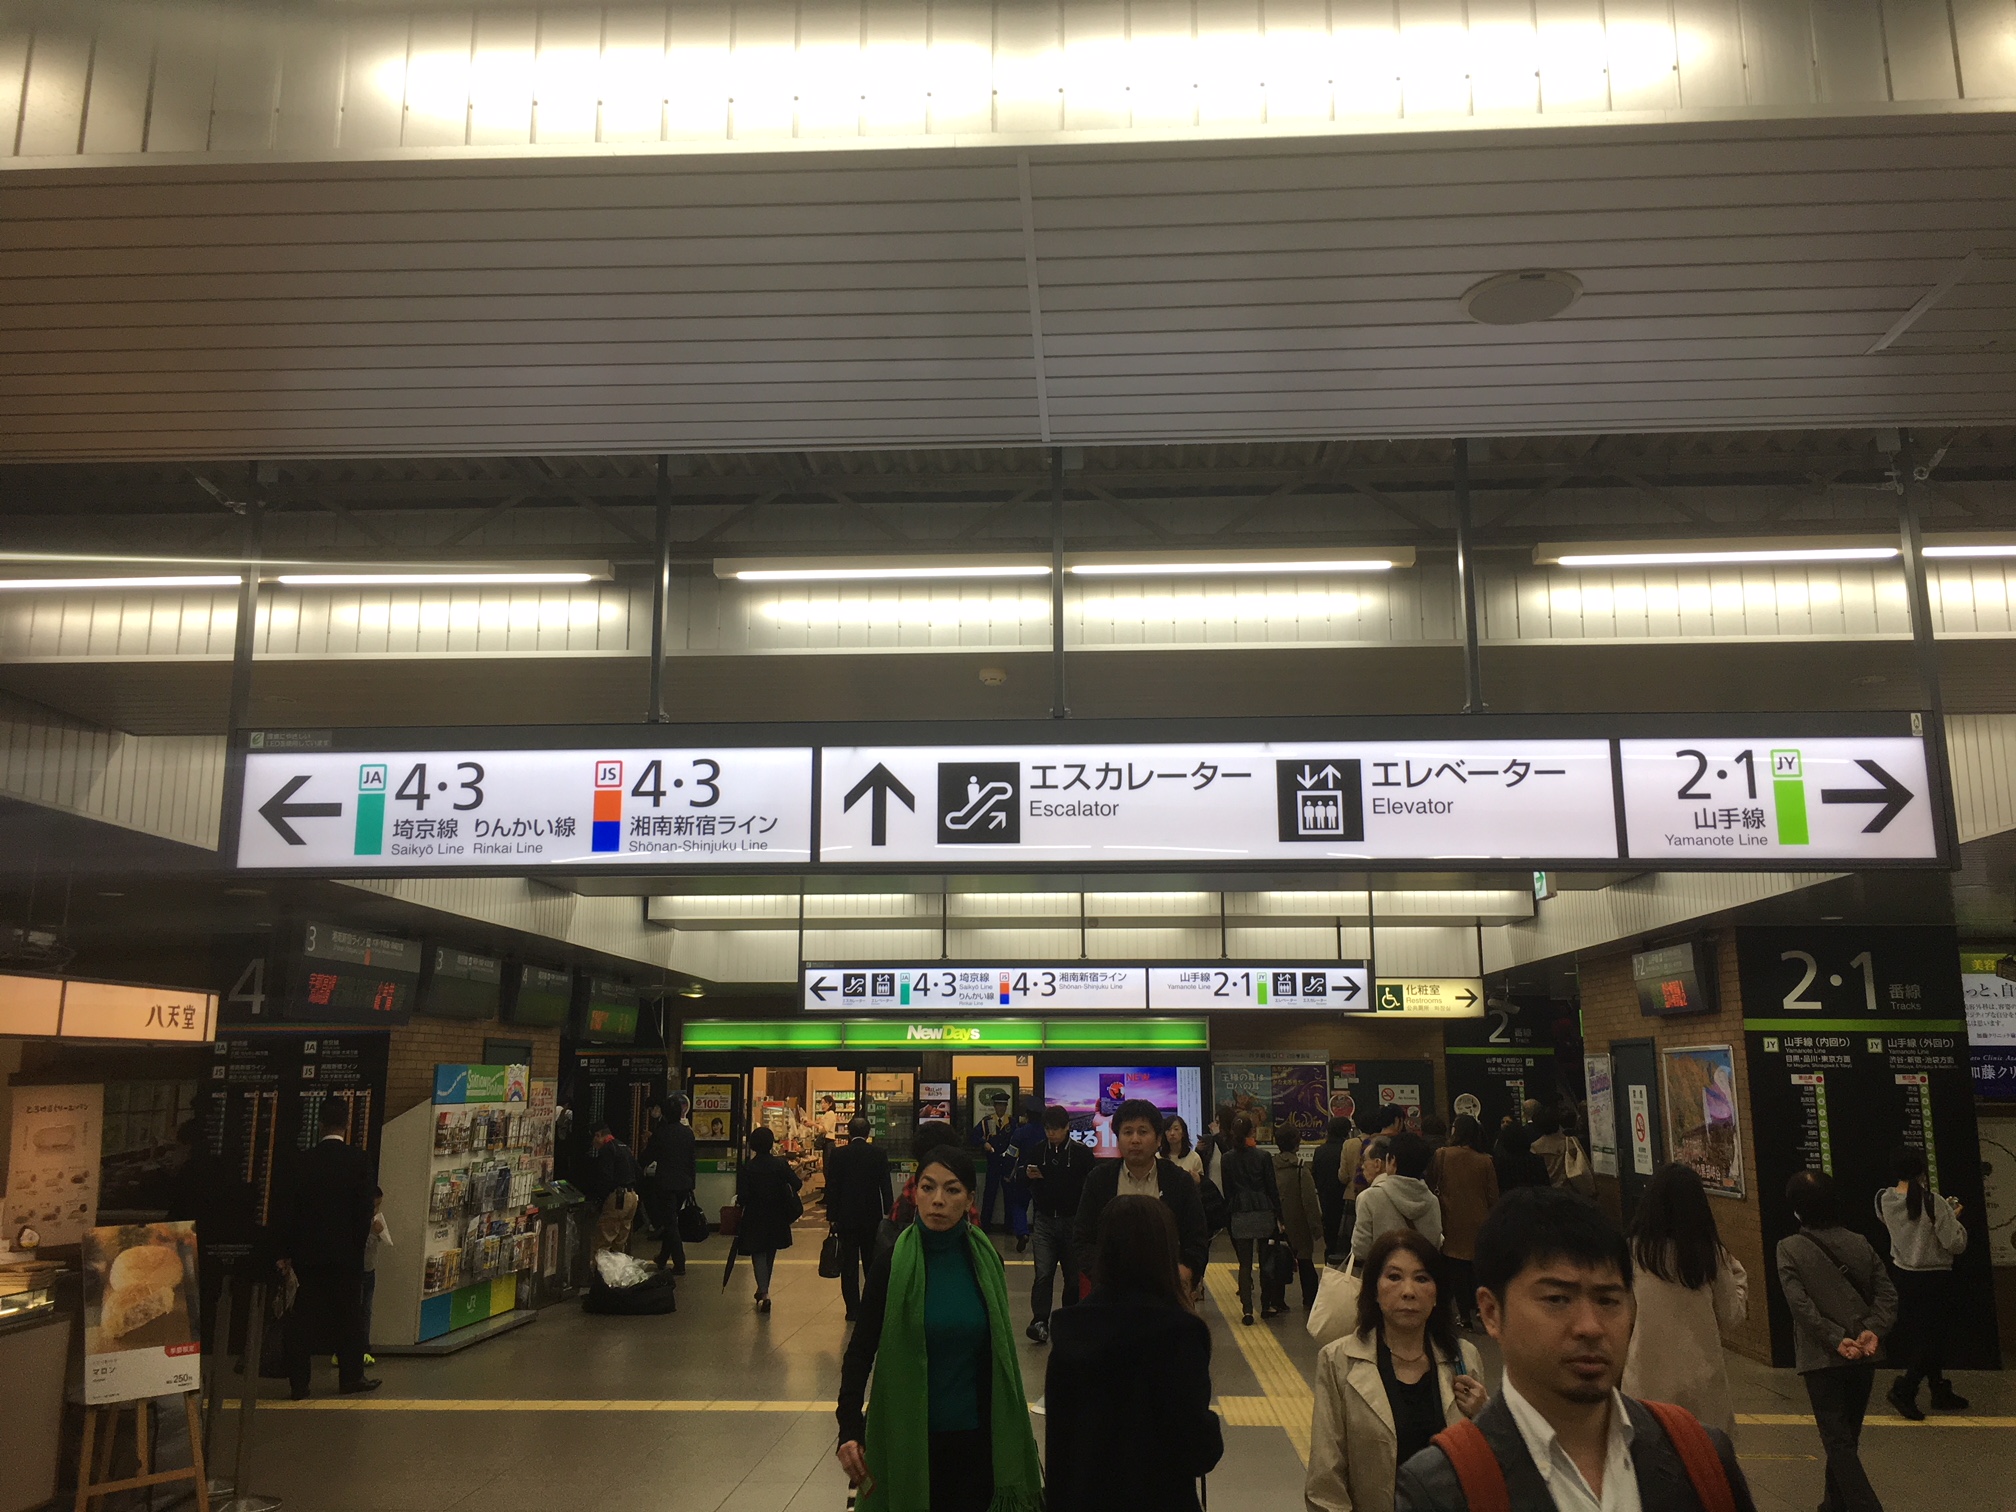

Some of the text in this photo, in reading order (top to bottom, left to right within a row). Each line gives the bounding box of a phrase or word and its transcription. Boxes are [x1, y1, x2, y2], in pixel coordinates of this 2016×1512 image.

[1777, 756, 1796, 770] JY
[363, 771, 382, 785] JA
[601, 767, 617, 781] JS
[1029, 761, 1251, 791] エスカレーター
[1372, 758, 1566, 788] エレベーター
[1029, 800, 1119, 817] Escalator
[1373, 797, 1454, 814] Elevator
[1694, 807, 1766, 830] 山手線
[392, 816, 577, 839] 埼京線 りんかい線
[630, 815, 778, 837] 湘南新宿ライン
[629, 840, 768, 854] Shōnan-Shinjuku Line
[1665, 834, 1768, 846] Yamanote Line
[391, 842, 543, 856] Saikyō Line Rinkai Line
[307, 926, 317, 952] 3
[436, 950, 444, 970] 3
[959, 972, 990, 982] 埼京線
[1059, 972, 1127, 982] 湘南新宿ライン
[1180, 972, 1210, 983] 山手線
[228, 958, 266, 1015] 4
[1406, 984, 1440, 996] 化粧室
[1889, 983, 1922, 999] 番線
[958, 992, 995, 1000] りんかい線
[1891, 1001, 1922, 1010] Tracks
[145, 1004, 196, 1030] 八天堂
[906, 1025, 981, 1041] NewDays
[1488, 1009, 1511, 1043] 2
[306, 1042, 316, 1051] JA
[1766, 1041, 1776, 1049] JY
[1870, 1041, 1880, 1049] JY
[214, 1067, 224, 1076] JS
[304, 1067, 313, 1076] JS
[1126, 1073, 1150, 1082] NEW
[1221, 1072, 1264, 1082] 王様の耳は
[1226, 1082, 1260, 1090] ロハの耳
[703, 1099, 719, 1109] 100
[1274, 1111, 1324, 1129] Aladdin
[466, 1294, 476, 1310] JR
[93, 1367, 116, 1375] マロン
